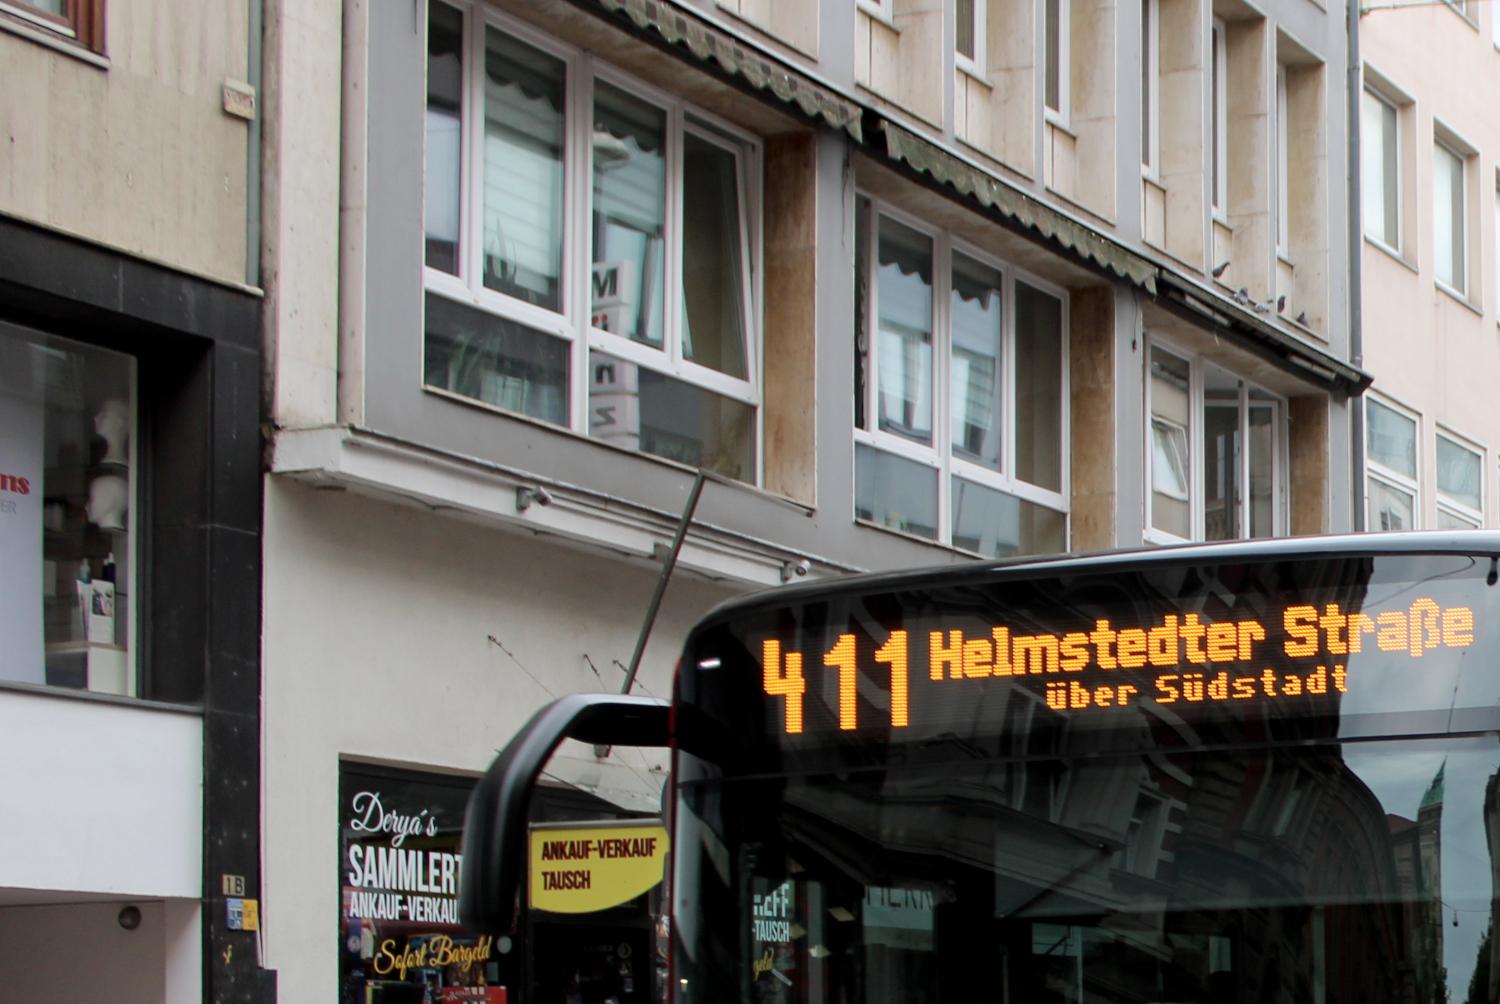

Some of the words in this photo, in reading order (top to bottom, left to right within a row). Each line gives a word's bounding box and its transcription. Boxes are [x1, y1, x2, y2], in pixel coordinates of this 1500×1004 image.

[929, 613, 1266, 680] Helmstedter
[1283, 597, 1475, 657] Straße
[763, 629, 908, 733] 411
[1046, 681, 1138, 710] über
[1155, 664, 1348, 704] Südstadt
[542, 837, 657, 860] ANKAUF-VERKAUF
[541, 870, 591, 890] TAUSCH
[350, 892, 462, 925] ANKAUF-VERKAU
[374, 939, 427, 981] Sofort
[430, 934, 492, 971] Bargeld
